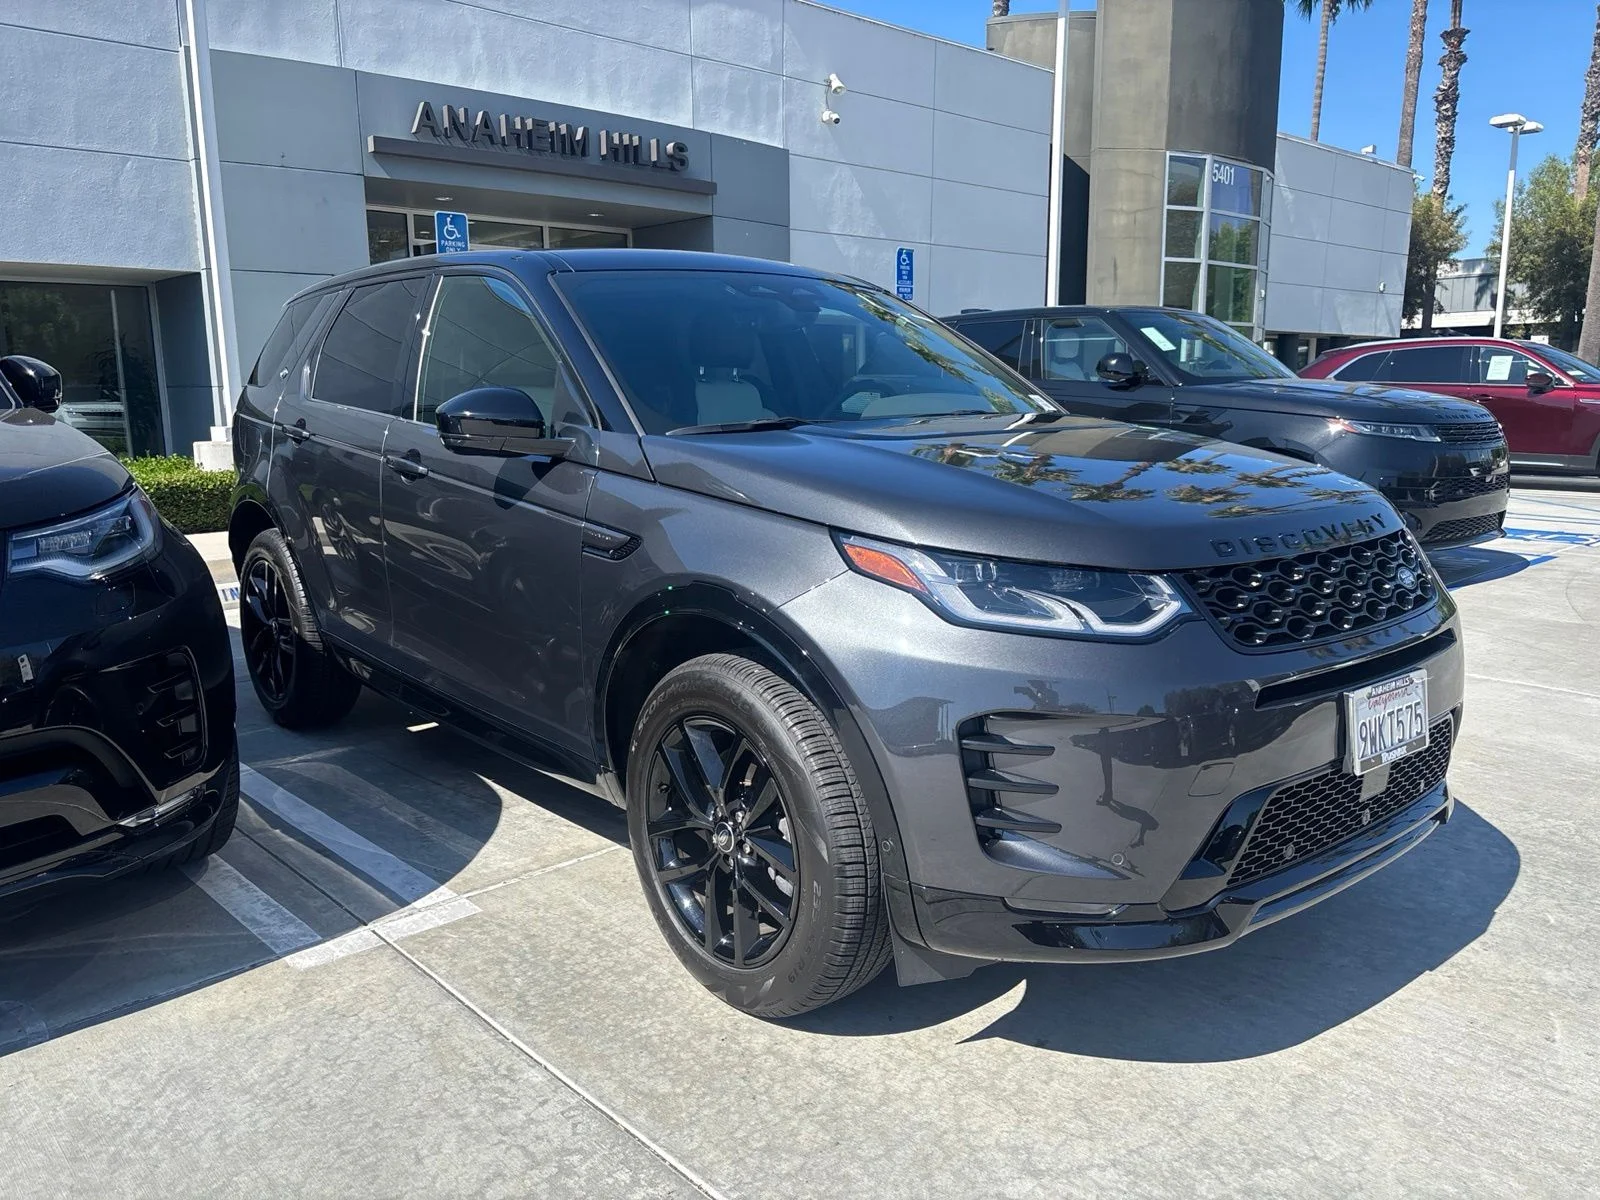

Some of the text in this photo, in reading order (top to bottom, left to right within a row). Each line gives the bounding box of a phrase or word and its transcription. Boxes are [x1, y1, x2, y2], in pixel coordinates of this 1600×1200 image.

[411, 101, 689, 172] ANAHEIM HILLS
[1212, 163, 1235, 186] 5401
[440, 240, 466, 248] PARKING
[1209, 512, 1387, 558] DISCOVERY
[1359, 701, 1423, 760] 9WKT575
